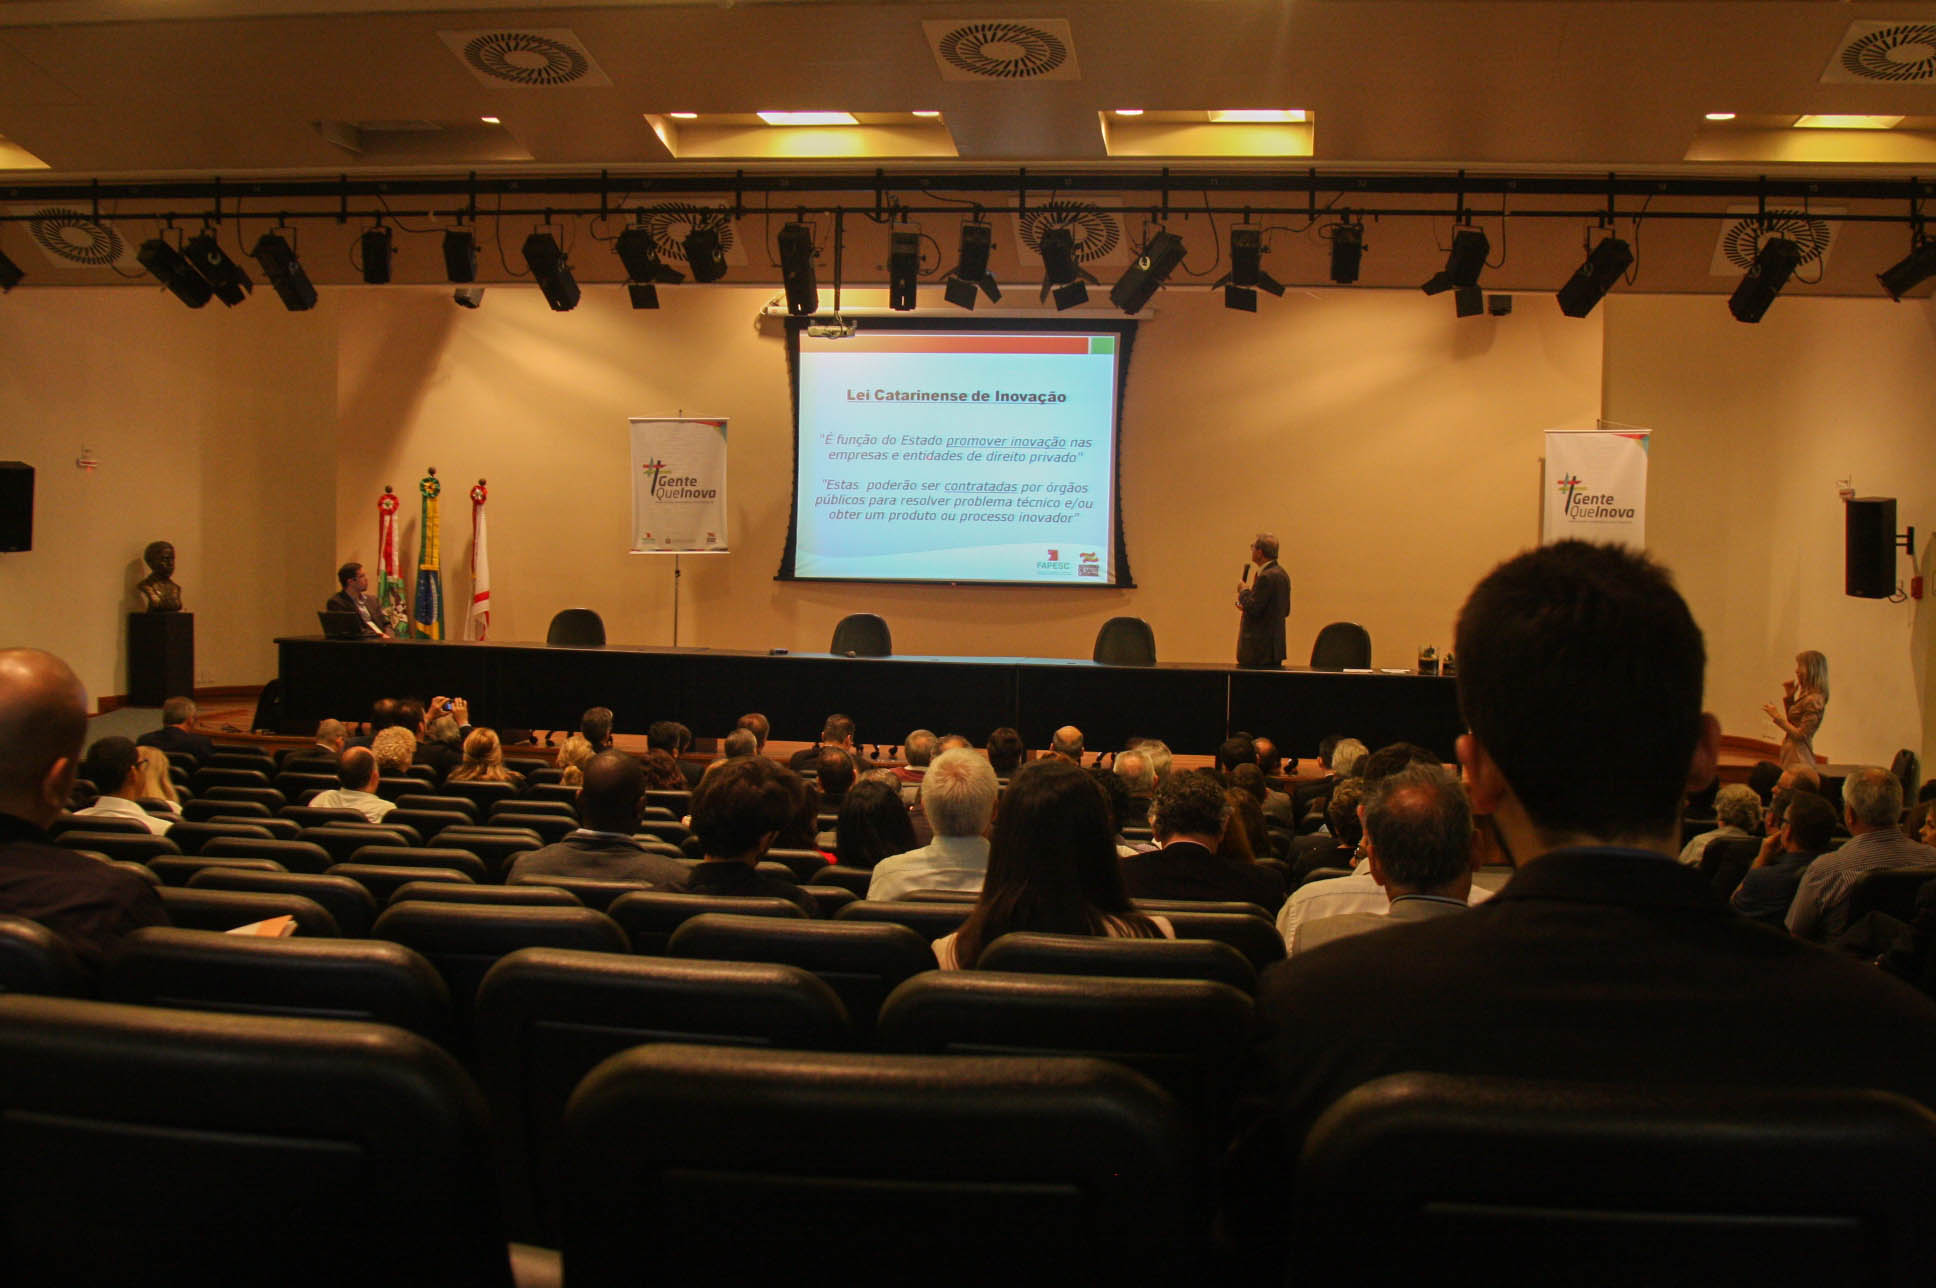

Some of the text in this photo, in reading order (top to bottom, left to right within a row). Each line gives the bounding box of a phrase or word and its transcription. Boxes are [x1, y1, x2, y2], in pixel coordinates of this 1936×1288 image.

[847, 389, 1067, 404] Lei Catarinense de Inovação
[836, 433, 877, 447] função
[881, 434, 897, 446] do
[901, 434, 942, 446] Estado
[946, 436, 1007, 449] promover
[1010, 436, 1066, 449] inovação
[1070, 438, 1092, 448] nas
[828, 450, 888, 462] empresas
[891, 451, 899, 461] e
[902, 450, 963, 461] entidades
[966, 450, 982, 461] de
[986, 450, 1026, 462] direito
[658, 475, 697, 487] Gente
[866, 479, 917, 493] poderão
[921, 481, 940, 491] ser
[944, 480, 1017, 493] contratadas
[1020, 483, 1043, 495] por
[1046, 481, 1089, 496] órgãos
[655, 488, 717, 501] QueInova
[1573, 493, 1614, 505] Gente
[815, 494, 1093, 510] públicos para resolver problema técnico e/ou
[828, 508, 861, 520] obter
[865, 511, 884, 520] um
[888, 509, 937, 523] produto
[940, 511, 956, 522] ou
[960, 511, 1015, 524] processo
[1570, 506, 1635, 520] QueInova
[1036, 561, 1071, 570] FAPESC
